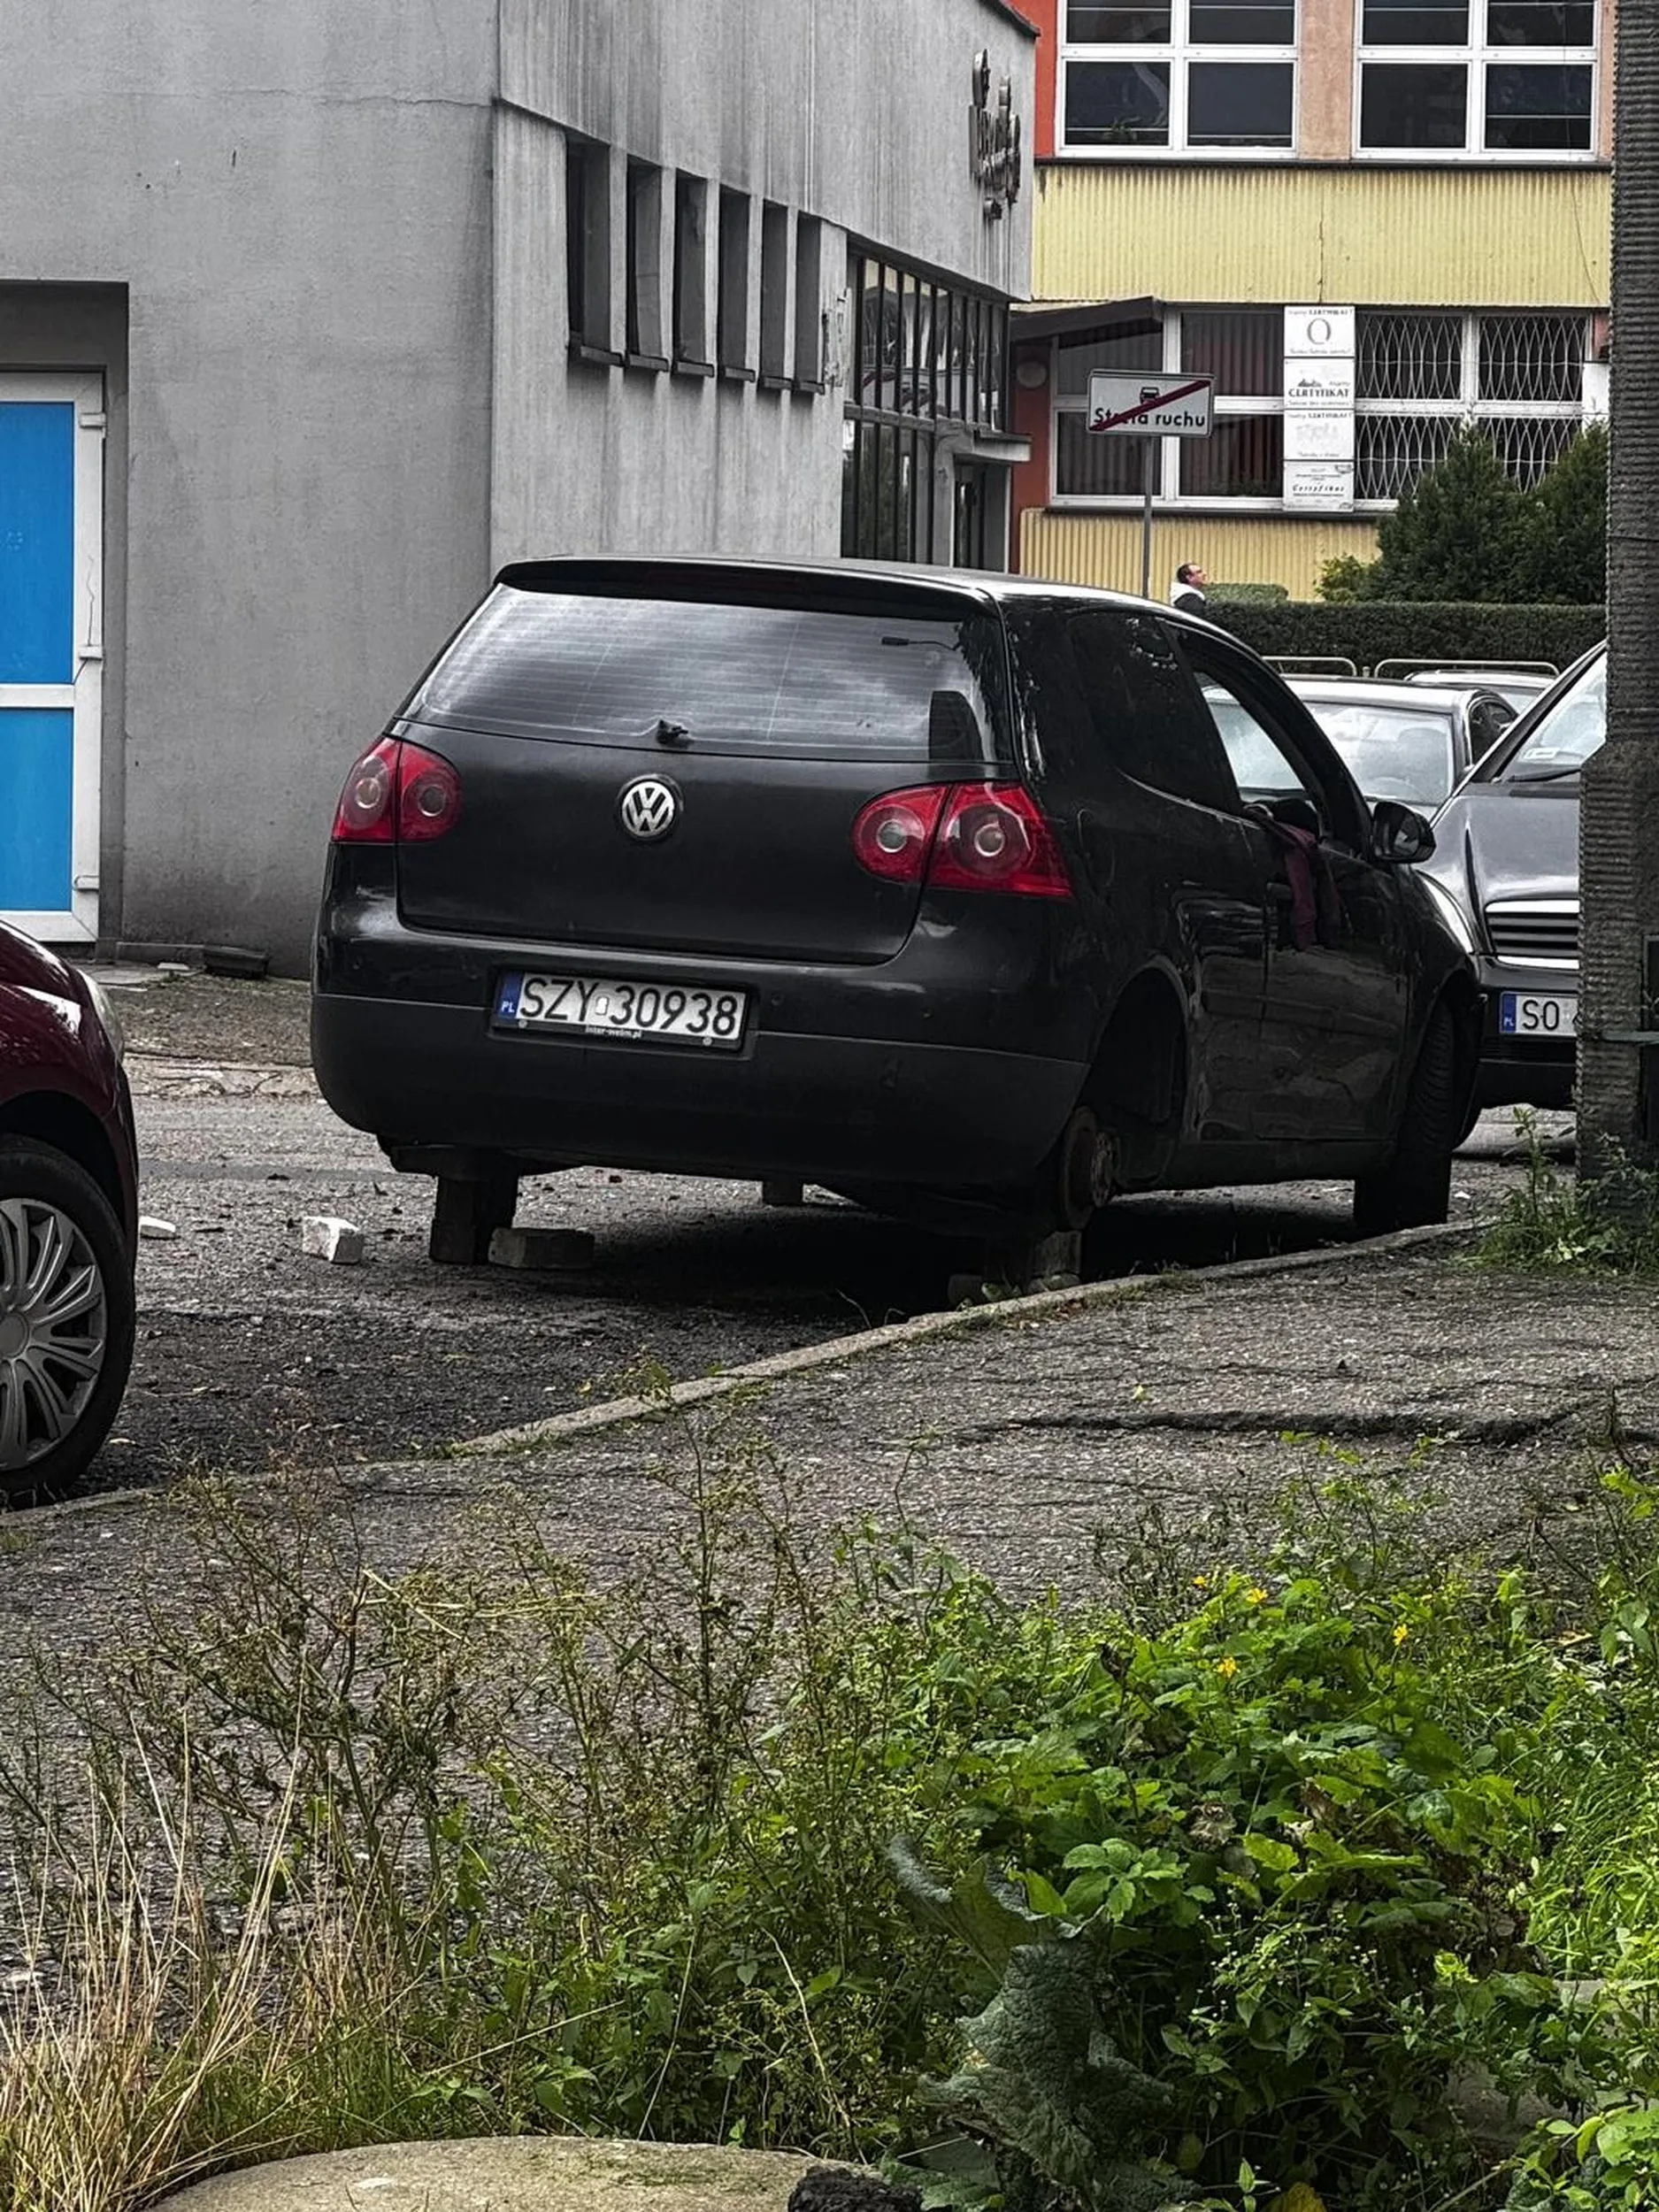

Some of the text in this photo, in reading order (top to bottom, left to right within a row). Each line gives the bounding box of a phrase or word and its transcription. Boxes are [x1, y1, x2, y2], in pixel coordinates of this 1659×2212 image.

[1288, 388, 1349, 397] CERTYFIKAT
[1155, 411, 1205, 426] ruchu
[501, 977, 738, 1036] PL SZY 30938
